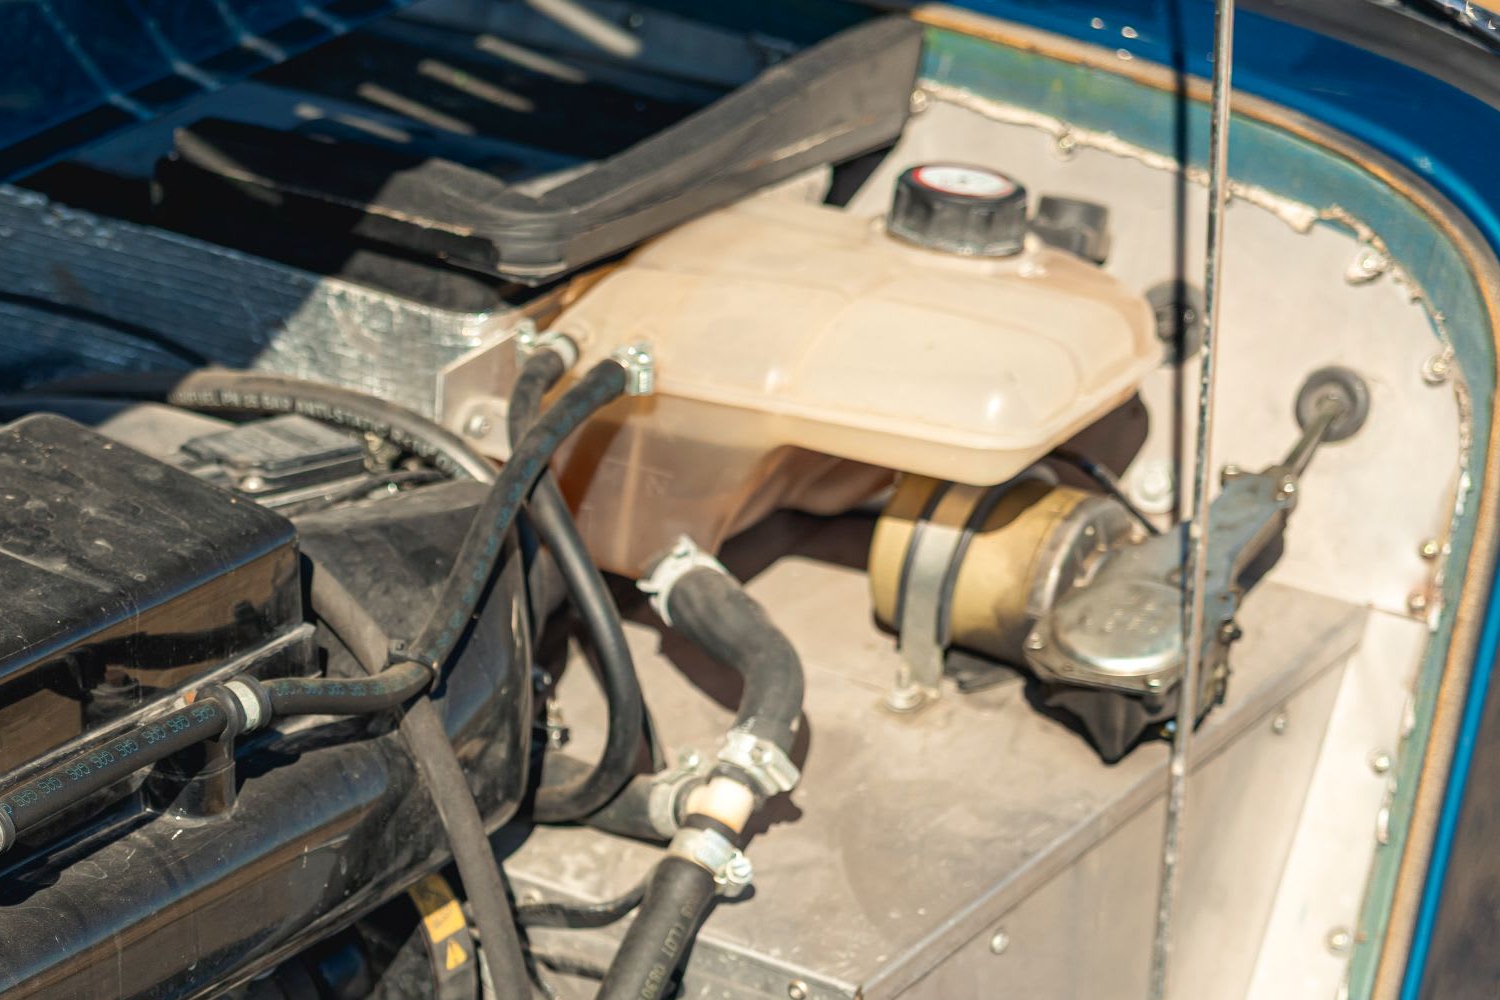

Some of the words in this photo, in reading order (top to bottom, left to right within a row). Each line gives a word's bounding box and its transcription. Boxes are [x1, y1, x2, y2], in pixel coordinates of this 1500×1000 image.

[191, 704, 216, 722] GAS
[167, 714, 191, 733] GAS
[142, 724, 167, 744] GAS
[114, 738, 139, 758] GAS
[90, 750, 114, 769] GAS
[65, 762, 91, 781] GAS
[37, 776, 62, 795] GAS
[11, 789, 39, 808] GAS
